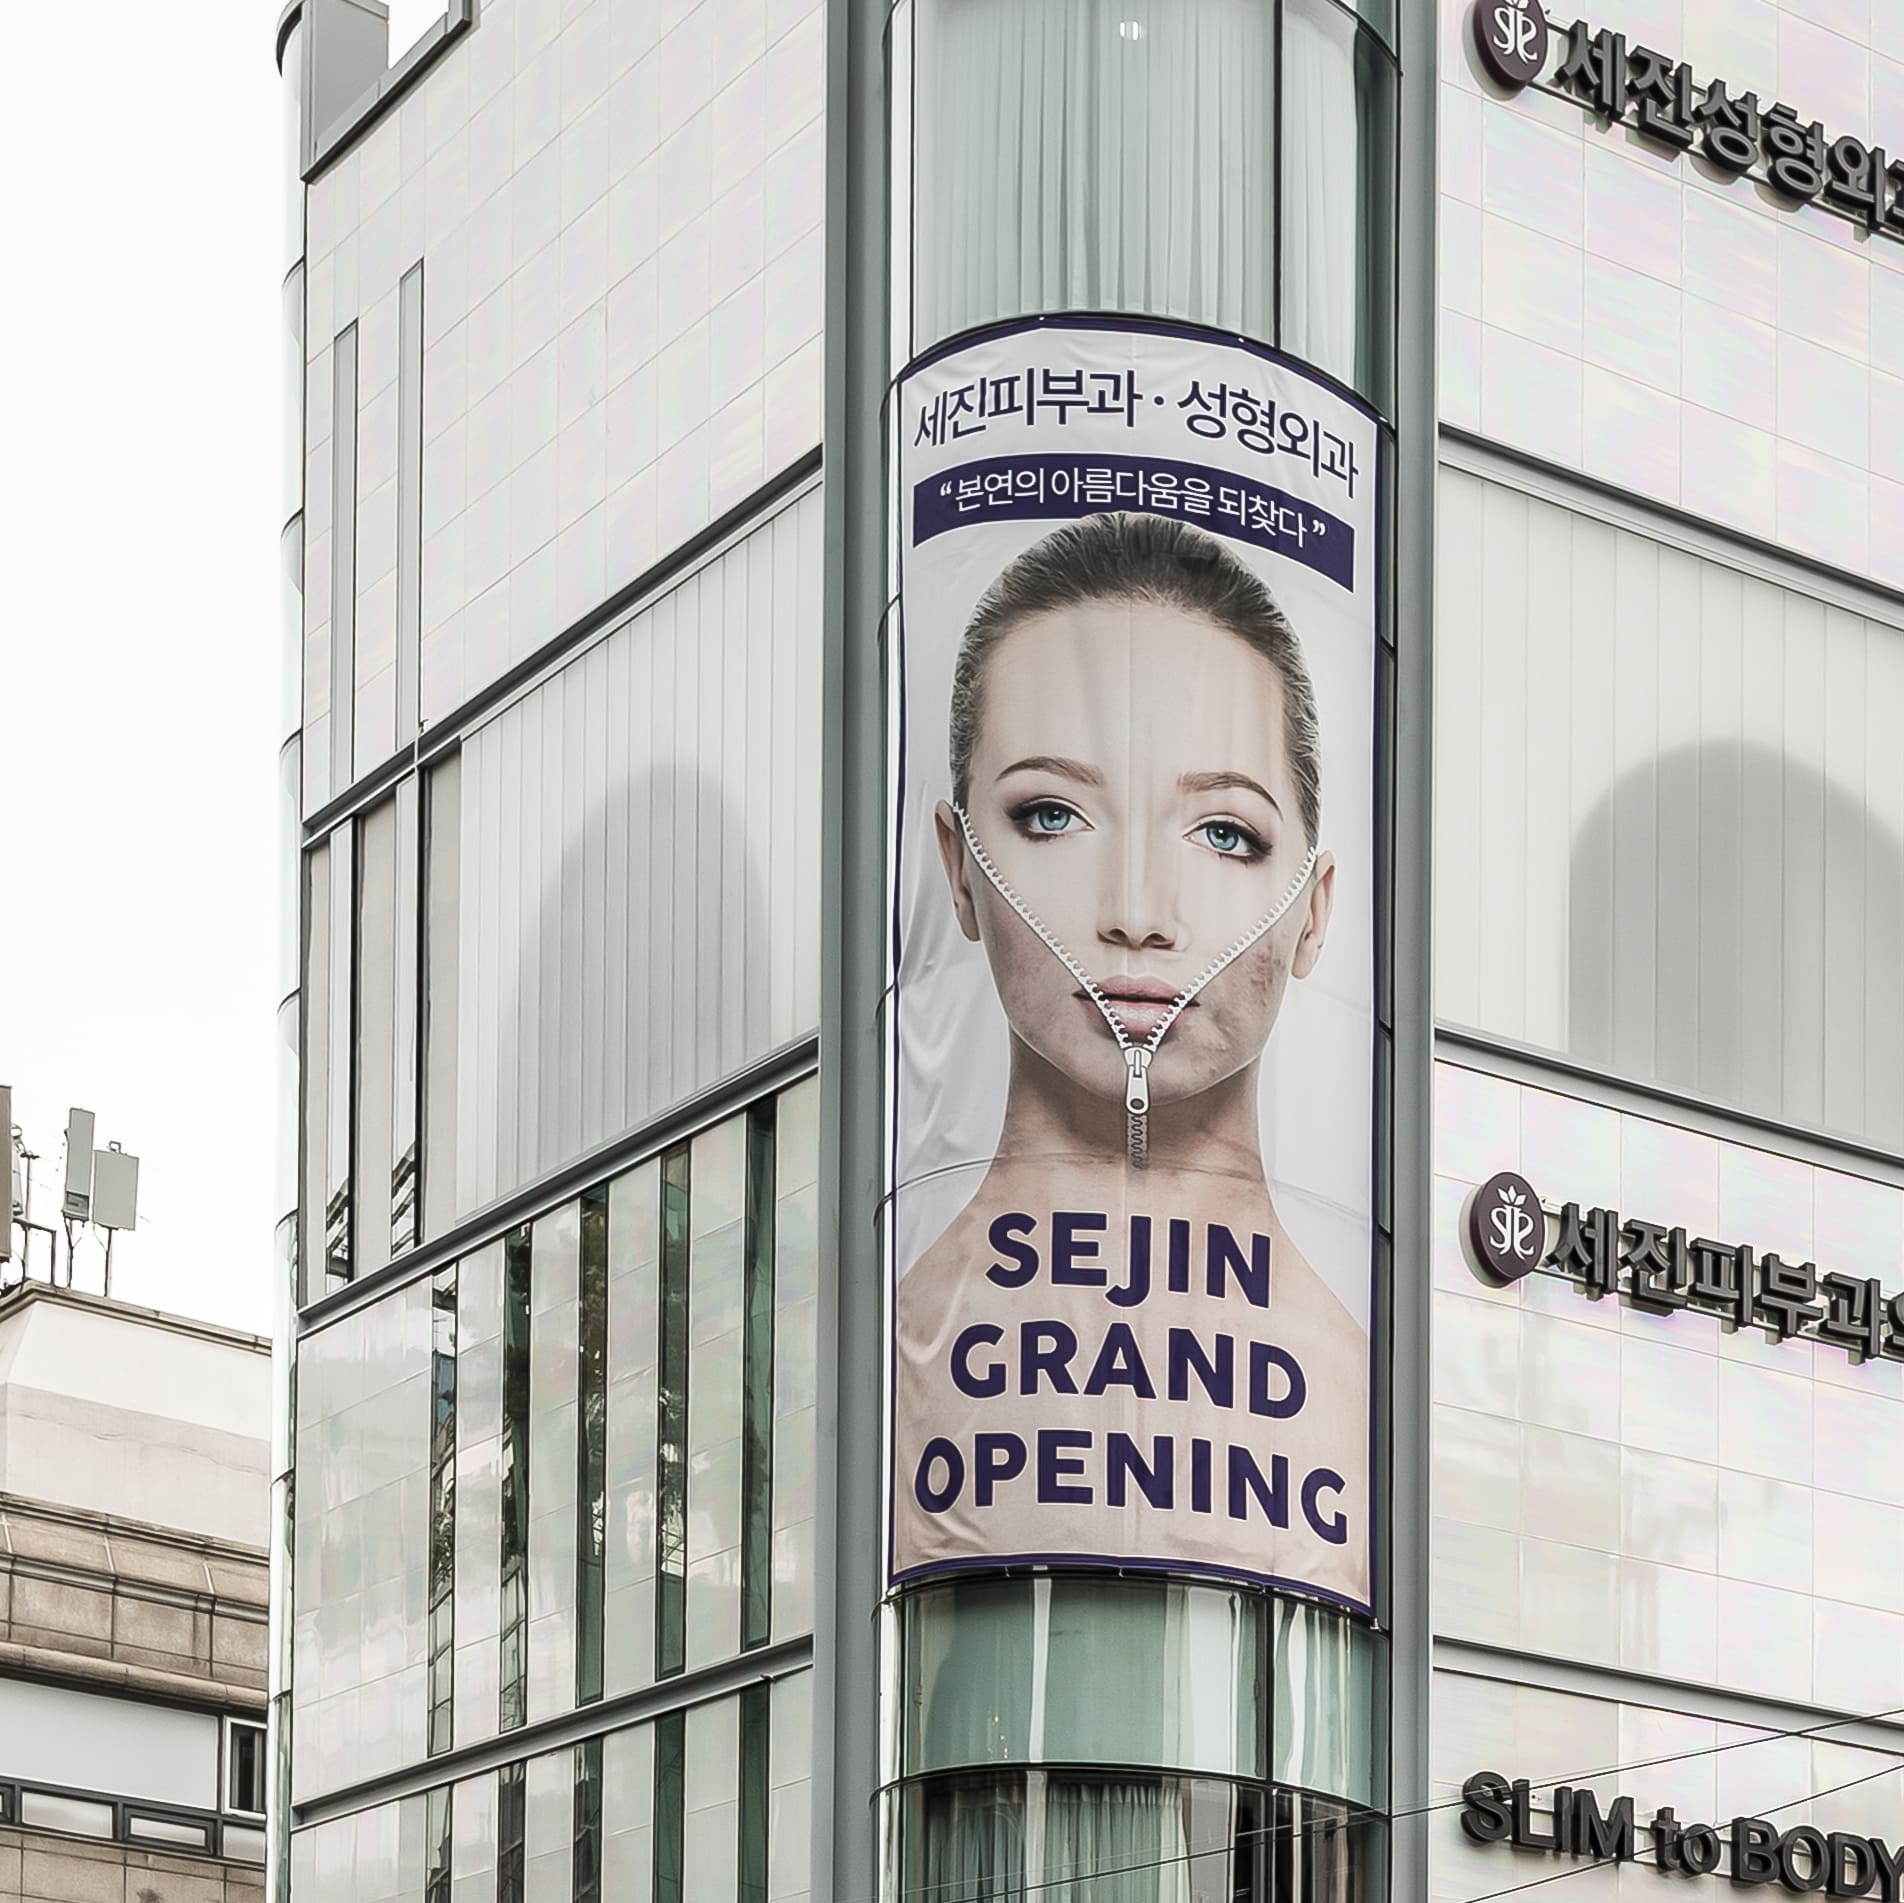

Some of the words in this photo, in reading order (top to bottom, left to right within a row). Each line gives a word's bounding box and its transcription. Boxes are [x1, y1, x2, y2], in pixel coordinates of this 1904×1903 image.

[1052, 469, 1213, 516] 아름다움을
[985, 1212, 1271, 1309] SEJIN
[951, 1320, 1307, 1419] GRAND
[915, 1429, 1347, 1545] OPENING
[1461, 1771, 1634, 1861] SLIM
[1652, 1807, 1722, 1876] to
